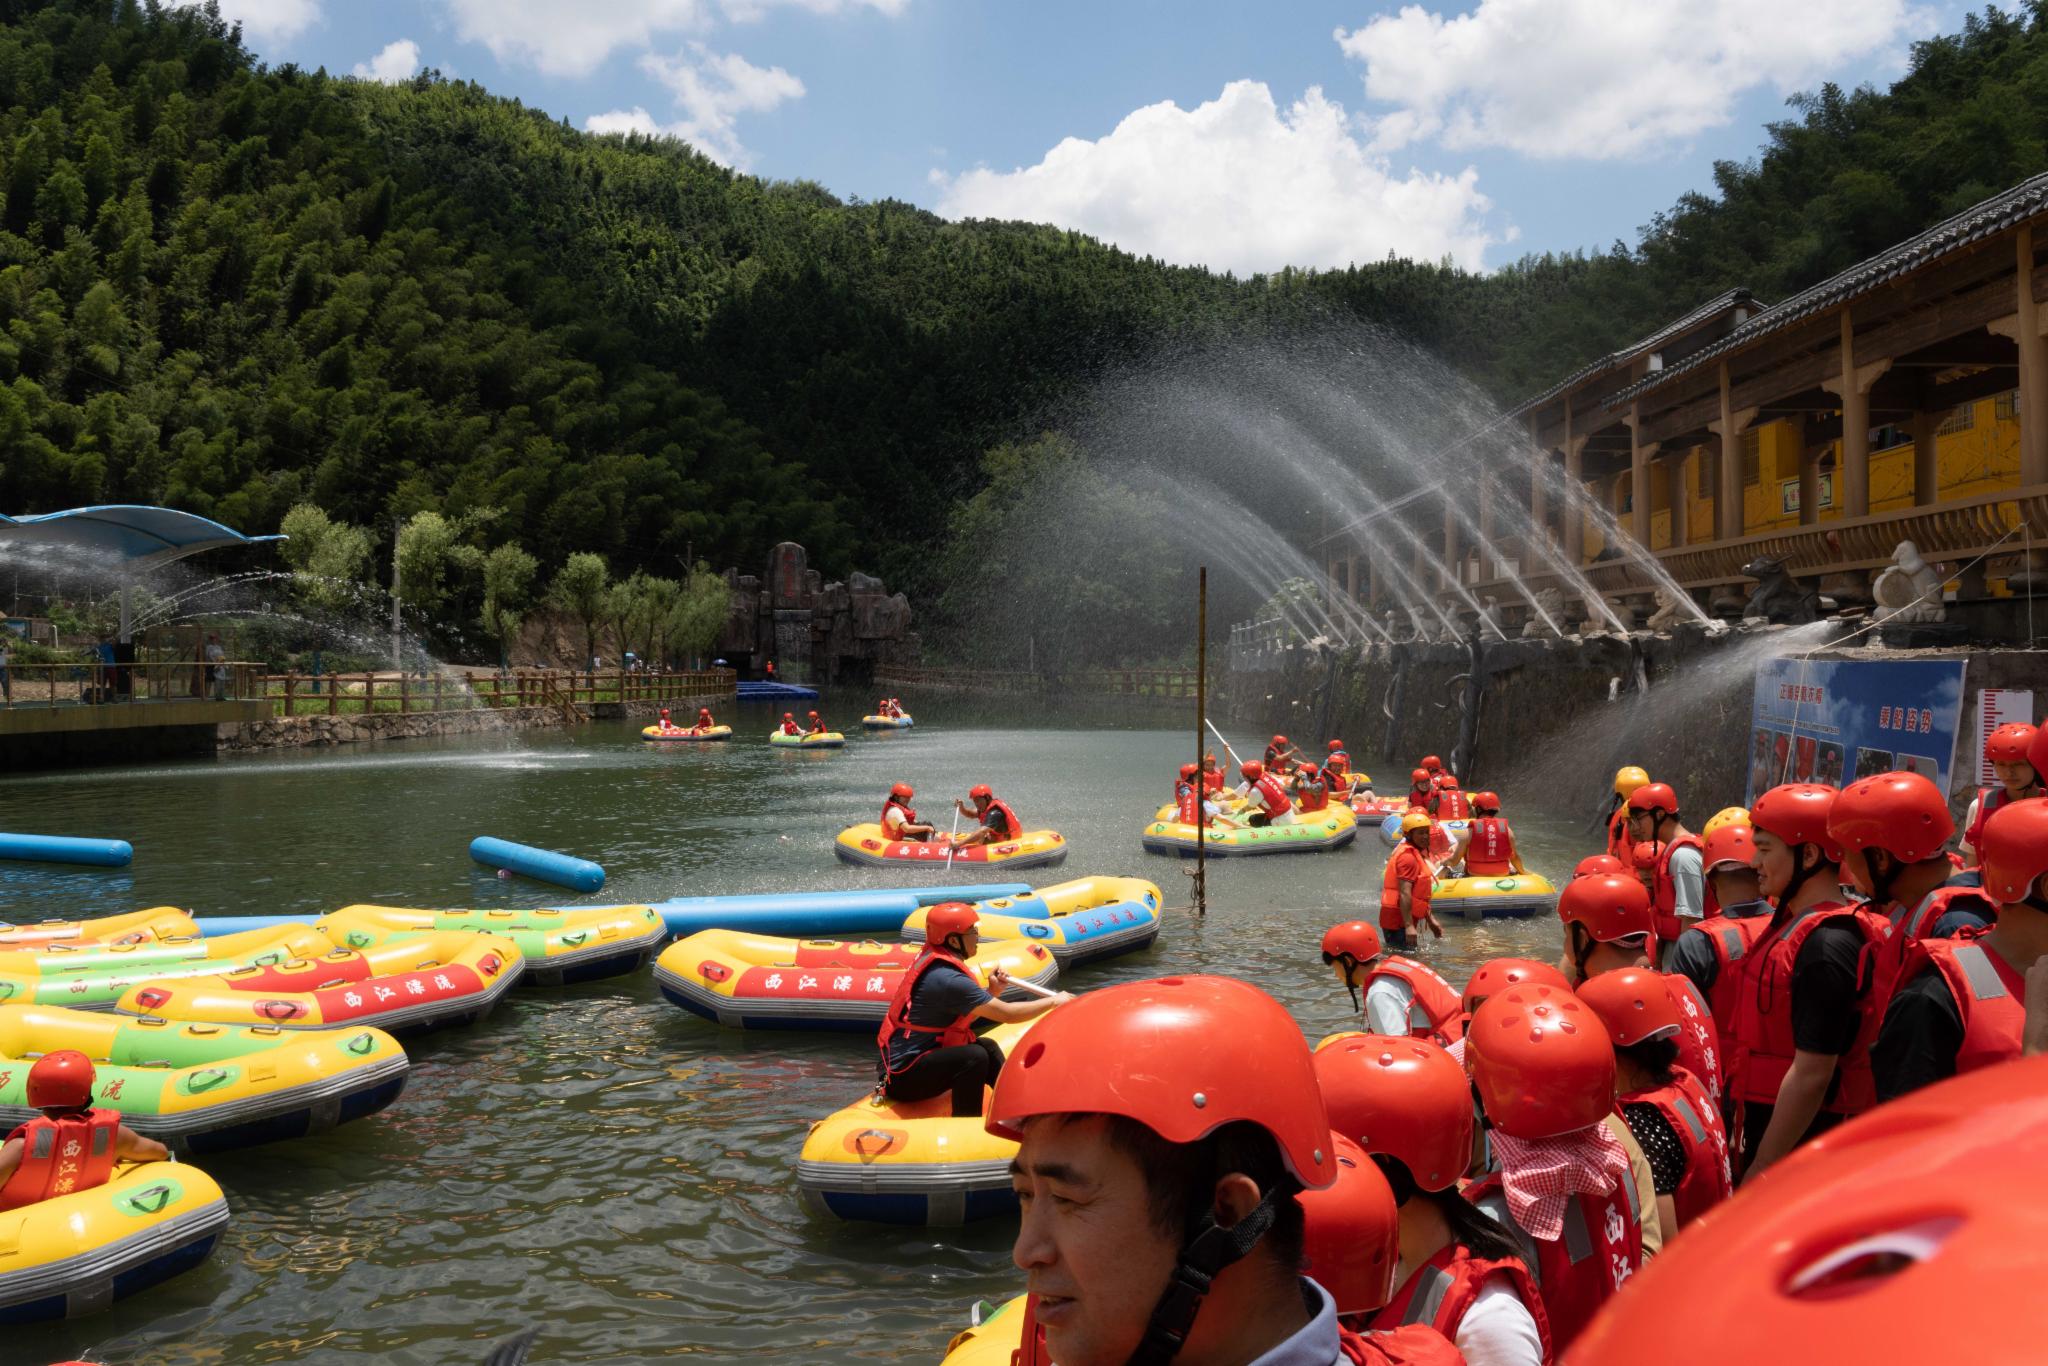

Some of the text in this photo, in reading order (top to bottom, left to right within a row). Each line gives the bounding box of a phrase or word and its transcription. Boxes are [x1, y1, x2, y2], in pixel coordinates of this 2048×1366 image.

[1879, 706, 1933, 734] 乘船姿势
[344, 974, 456, 1008] 西江漂流
[765, 974, 886, 993] 西江漂流
[1682, 995, 1721, 1100] 西江漂流
[1605, 1202, 1633, 1293] 西江
